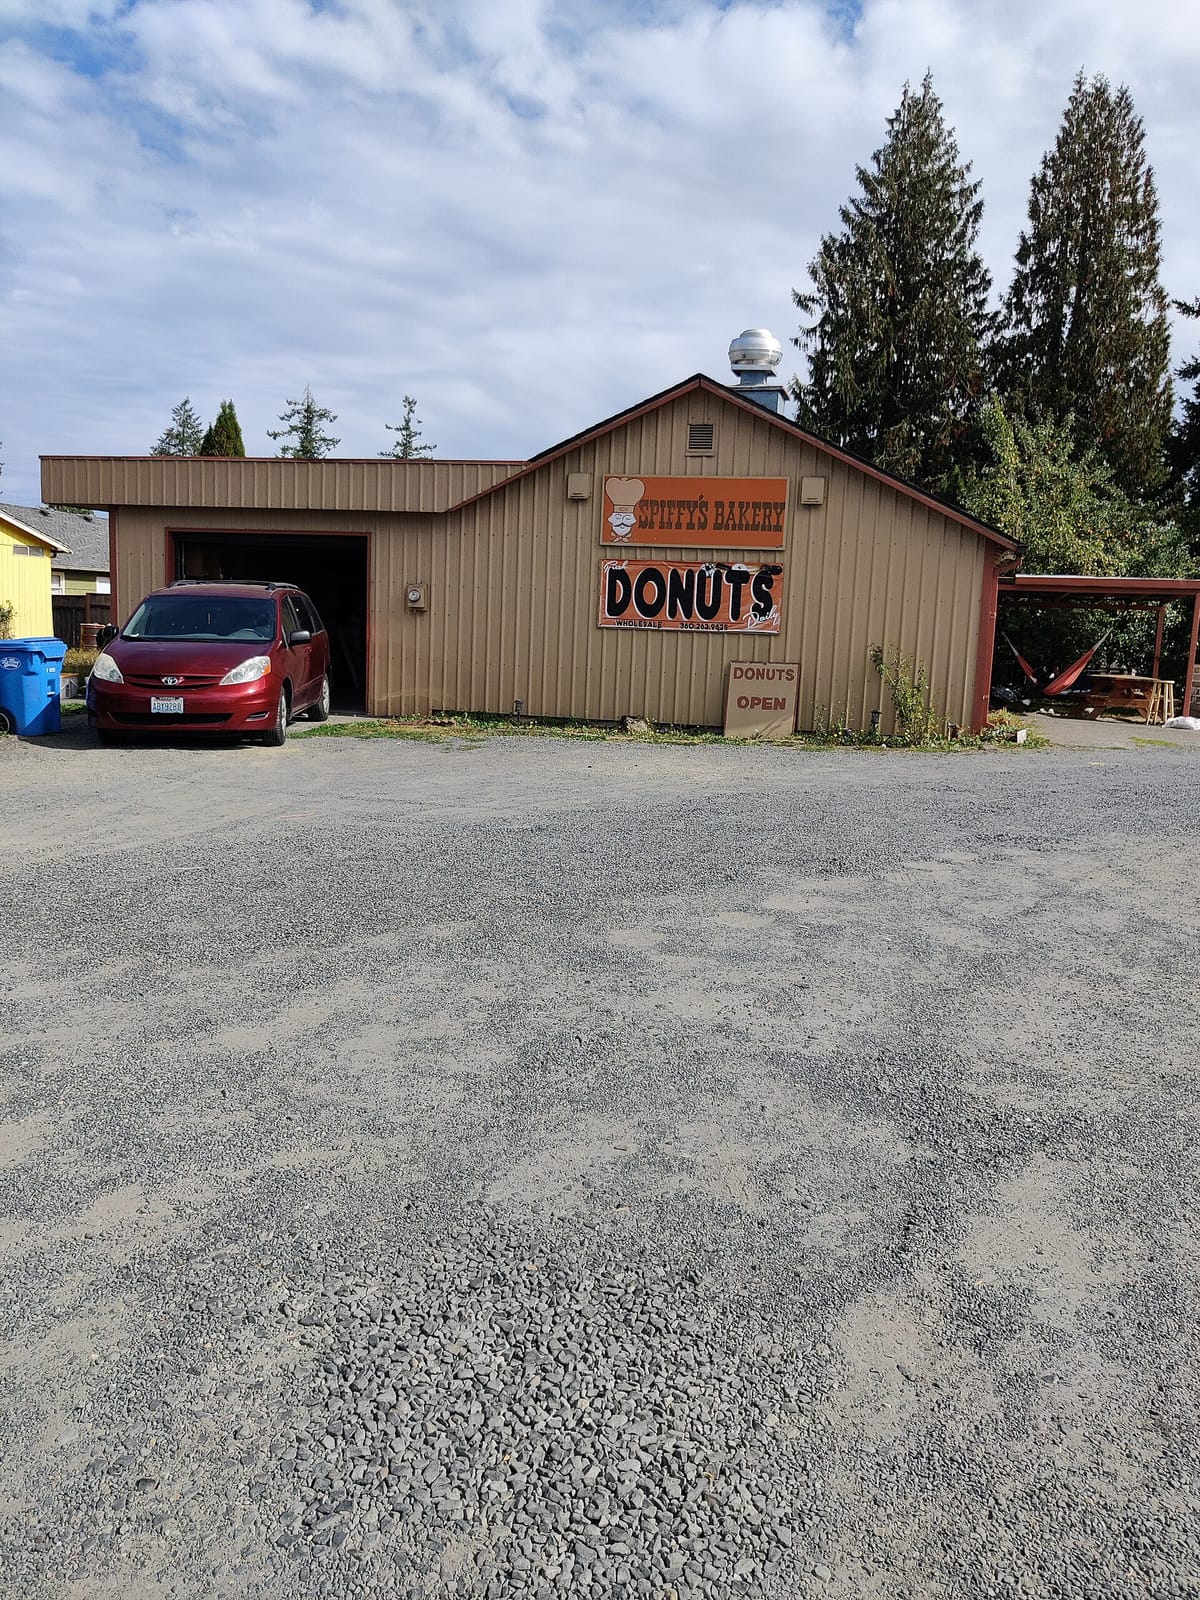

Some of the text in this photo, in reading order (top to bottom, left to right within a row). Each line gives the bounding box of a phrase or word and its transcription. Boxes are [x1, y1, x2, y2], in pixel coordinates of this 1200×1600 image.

[639, 495, 785, 532] SPIFFY'S BAKERY
[605, 566, 774, 622] DONUTS
[615, 620, 663, 629] WHOLESALE
[742, 604, 779, 629] Daily
[733, 667, 795, 681] DONUTS
[737, 696, 786, 710] OPEN
